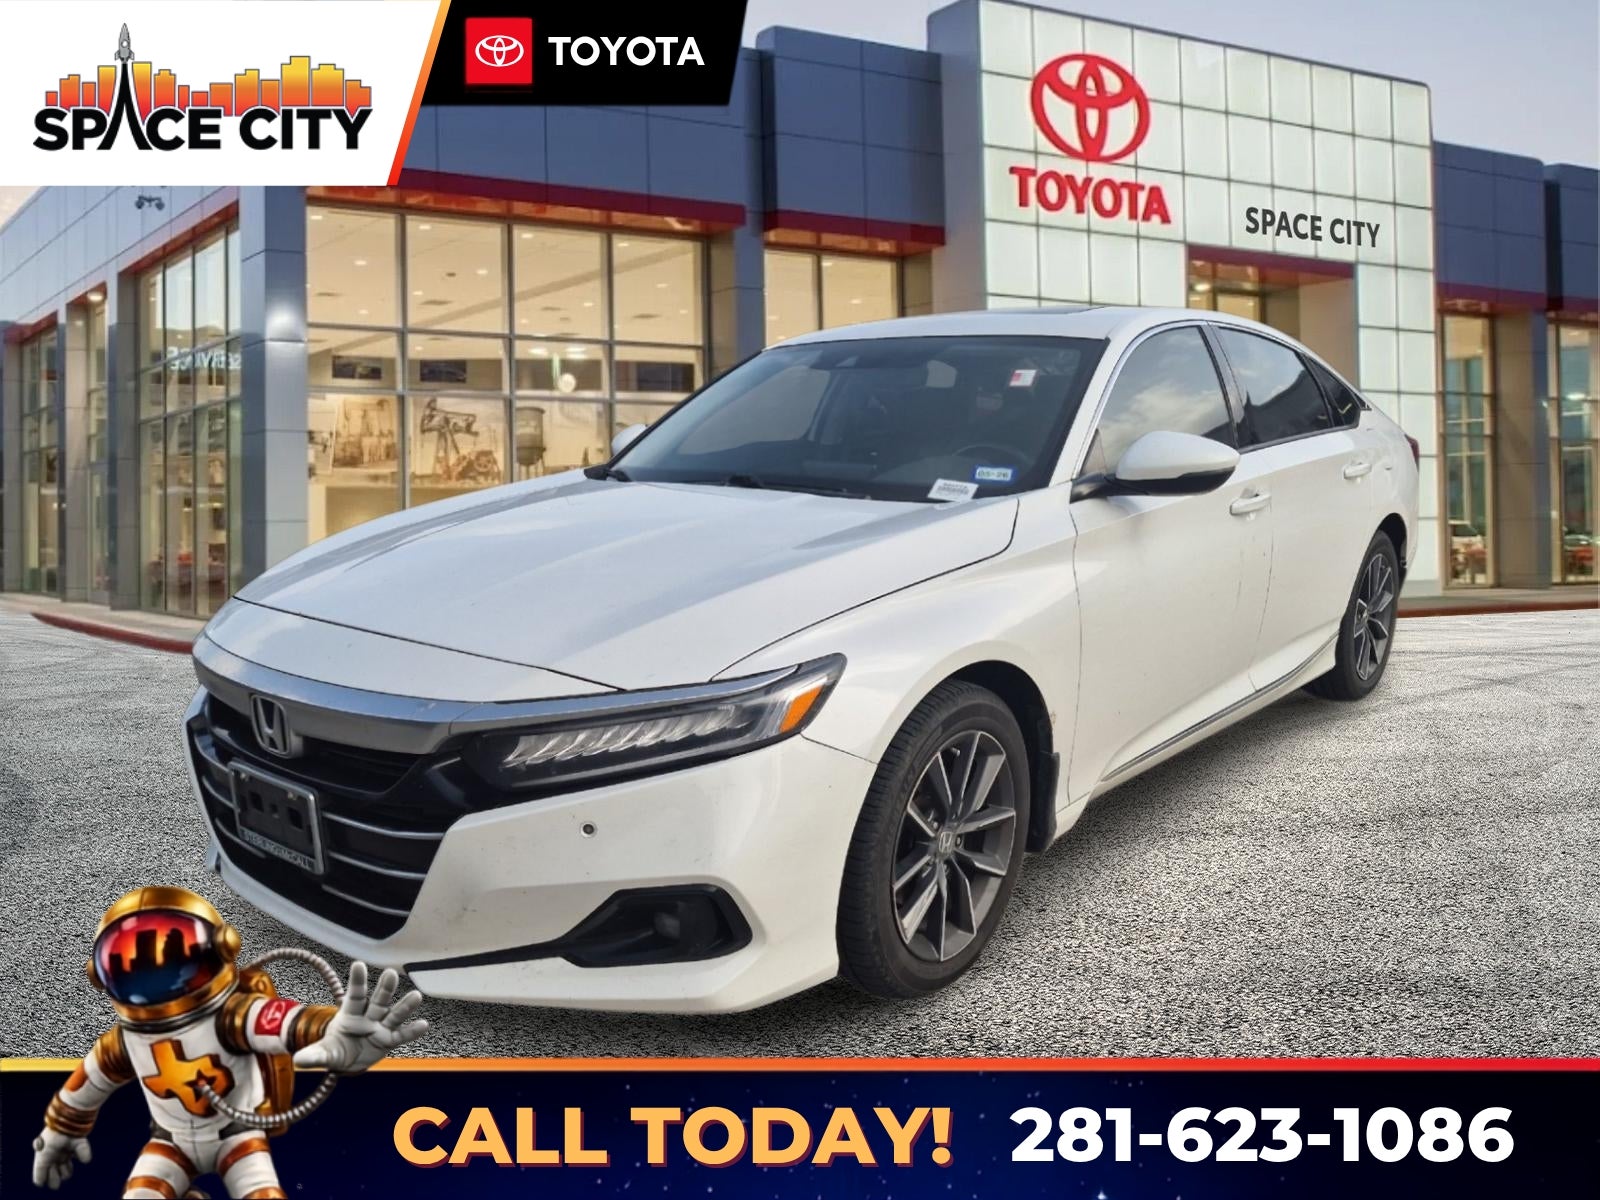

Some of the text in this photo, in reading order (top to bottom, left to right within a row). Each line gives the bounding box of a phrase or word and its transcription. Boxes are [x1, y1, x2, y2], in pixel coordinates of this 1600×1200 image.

[1009, 166, 1172, 224] TOYOTA
[1244, 206, 1381, 249] SPACE CITY
